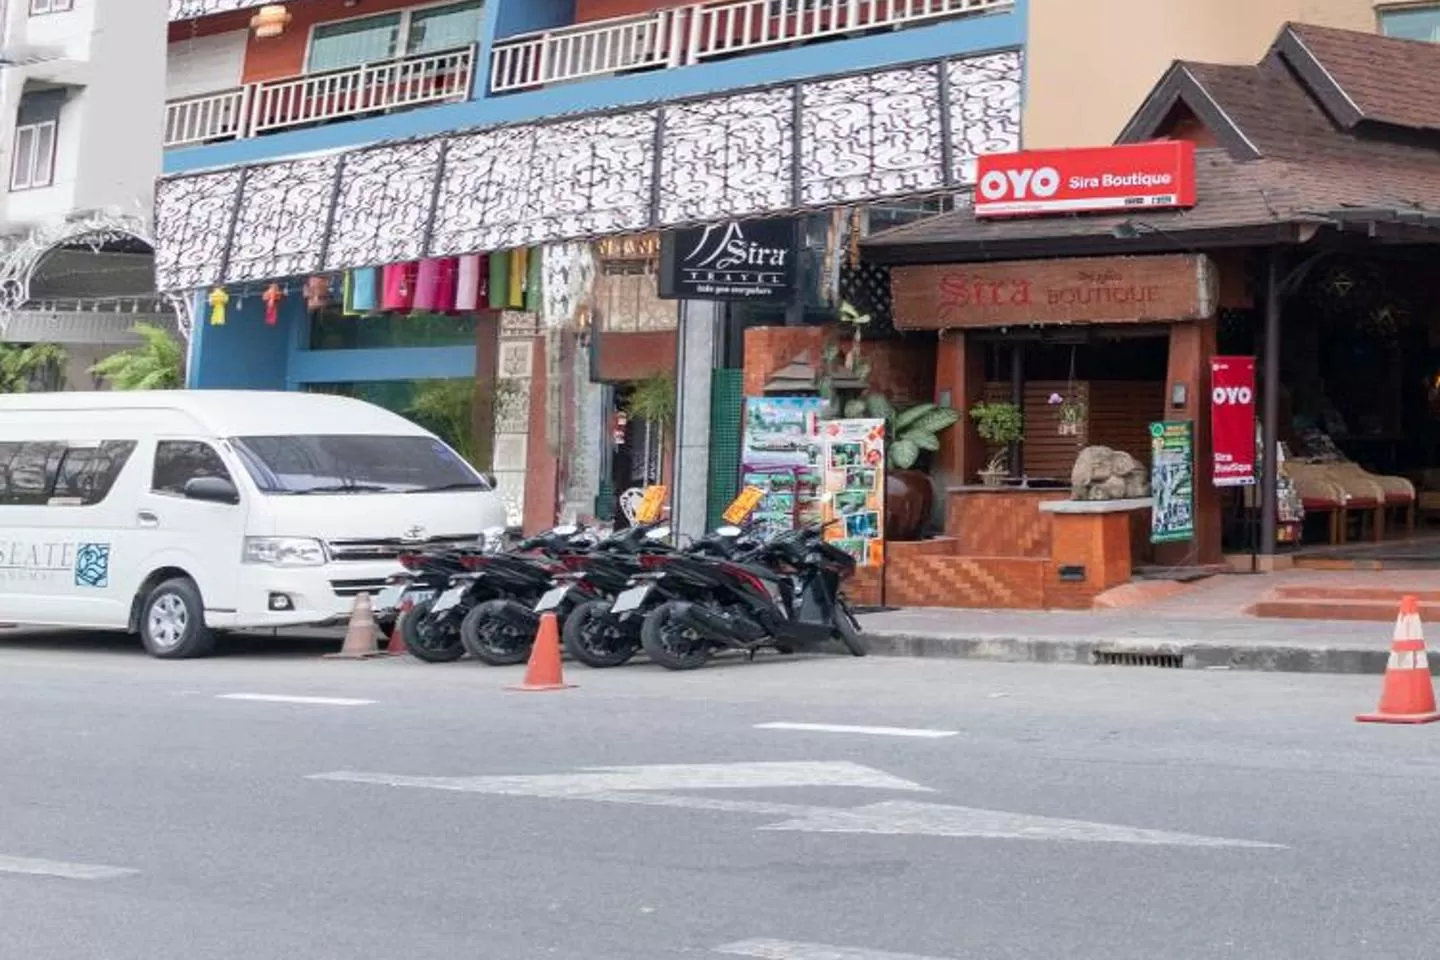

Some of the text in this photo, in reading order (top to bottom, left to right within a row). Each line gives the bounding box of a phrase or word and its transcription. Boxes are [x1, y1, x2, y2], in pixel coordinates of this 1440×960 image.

[980, 166, 1172, 200] OYO Sira Boutique
[716, 239, 788, 269] Sira
[691, 271, 780, 284] TRAVEL
[937, 271, 1161, 320] Sira BOUTIQUE
[1212, 387, 1252, 405] OYO
